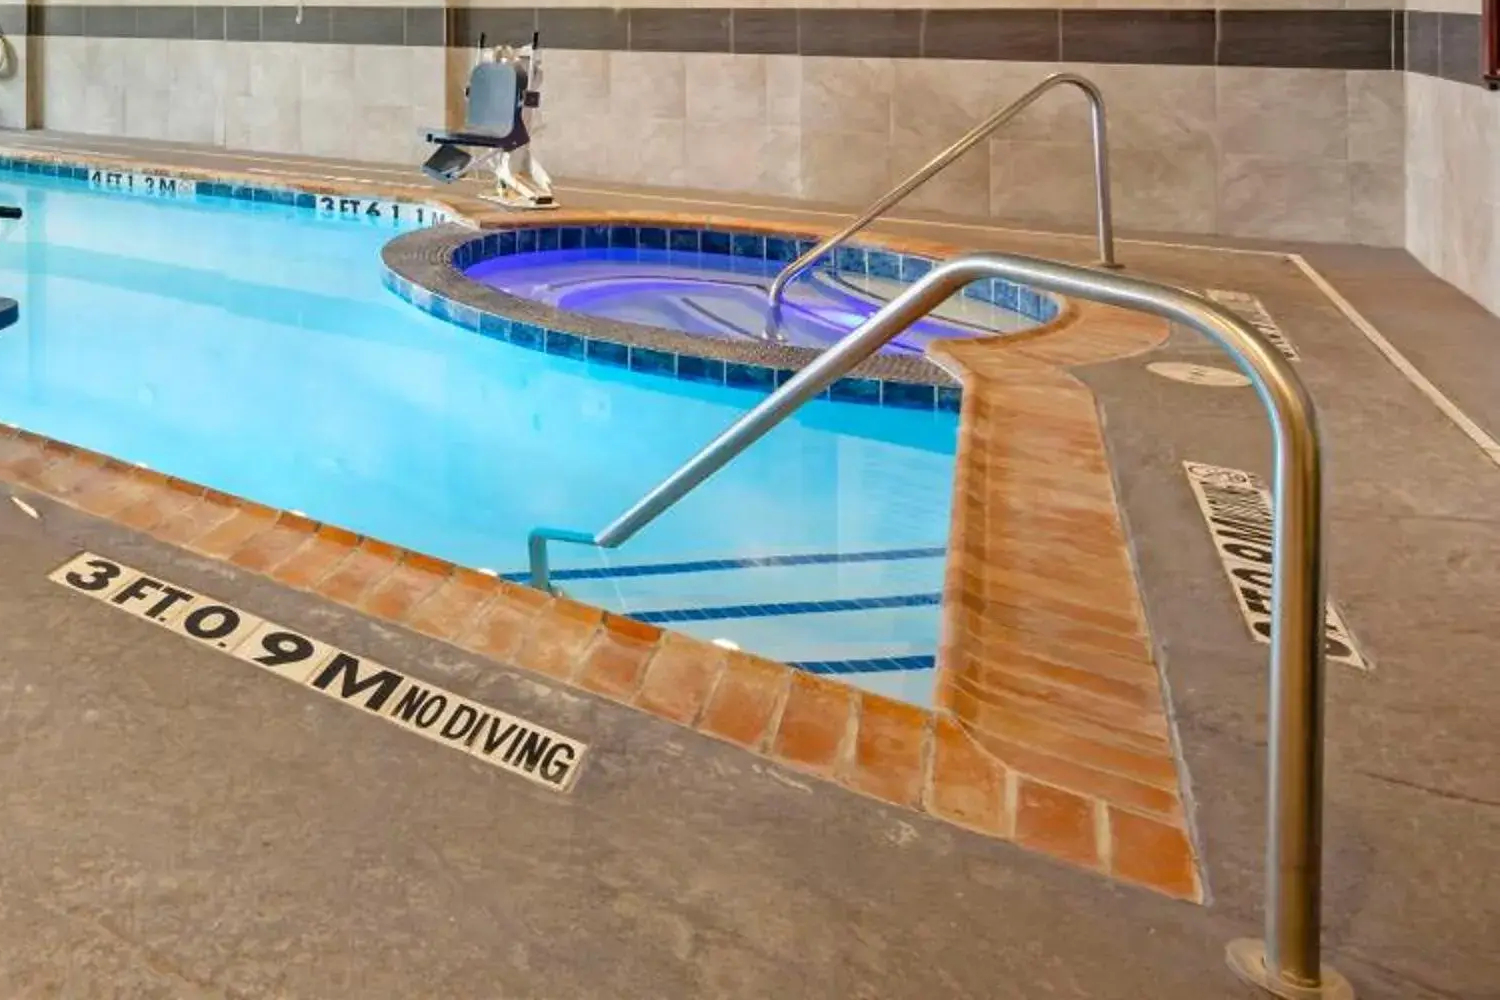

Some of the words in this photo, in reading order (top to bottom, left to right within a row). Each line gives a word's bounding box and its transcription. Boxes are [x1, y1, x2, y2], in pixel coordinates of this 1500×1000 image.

[107, 173, 122, 186] FT
[159, 178, 175, 194] M
[340, 199, 360, 215] FT
[65, 559, 121, 591] 3
[111, 577, 194, 622] FT.
[312, 653, 404, 711] M
[393, 686, 448, 728] NO
[440, 704, 575, 784] DIVING
